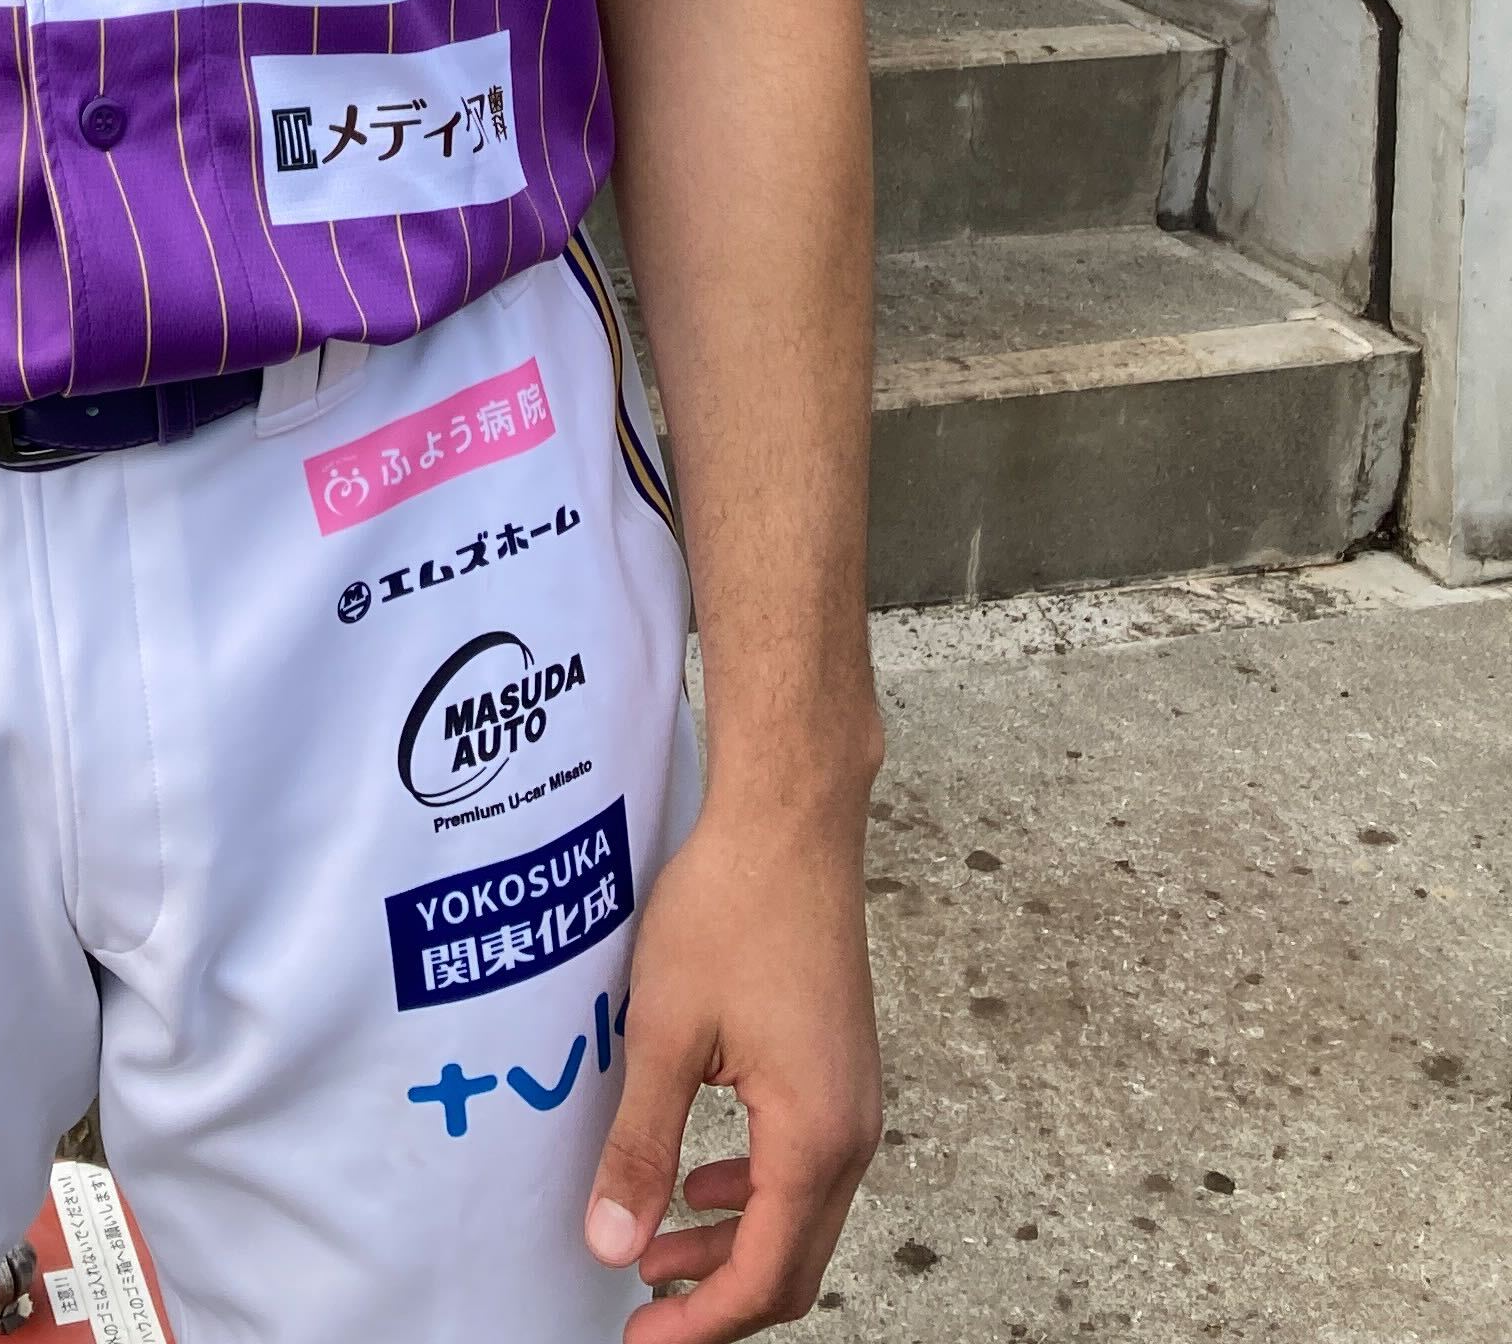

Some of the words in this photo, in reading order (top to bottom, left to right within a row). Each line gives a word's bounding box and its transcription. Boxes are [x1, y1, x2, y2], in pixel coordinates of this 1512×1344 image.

[380, 382, 548, 487] ふよう病院
[379, 504, 581, 603] エムズホーム
[444, 652, 586, 741] MASUDA
[451, 706, 547, 773] AUTO
[433, 801, 506, 833] Premium
[508, 783, 547, 810] U-car
[548, 760, 593, 791] Misato
[415, 828, 612, 932] YOKOSUKA
[421, 870, 619, 992] 関東化成
